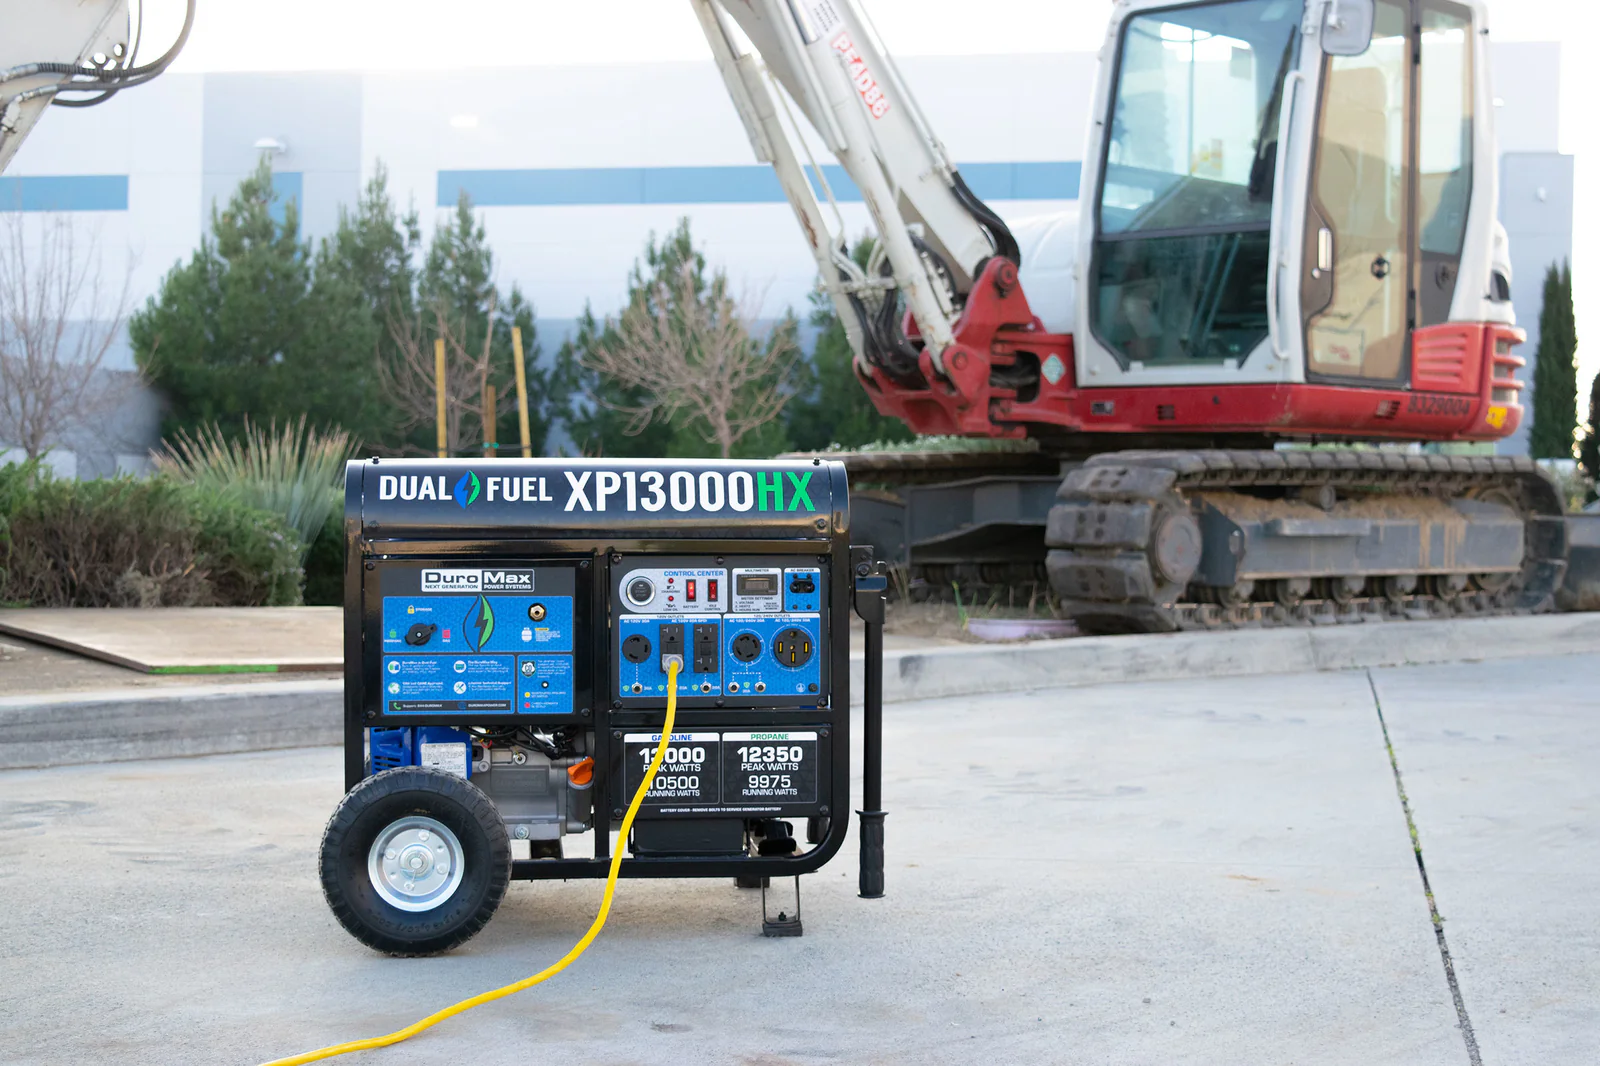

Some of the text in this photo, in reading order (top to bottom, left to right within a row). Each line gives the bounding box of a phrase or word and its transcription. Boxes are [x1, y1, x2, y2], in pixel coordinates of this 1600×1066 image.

[379, 471, 816, 512] DUAL FUEL XP13000HX
[737, 746, 803, 762] 12350
[741, 763, 798, 771] PEAK WATTS
[749, 775, 791, 788] 9975
